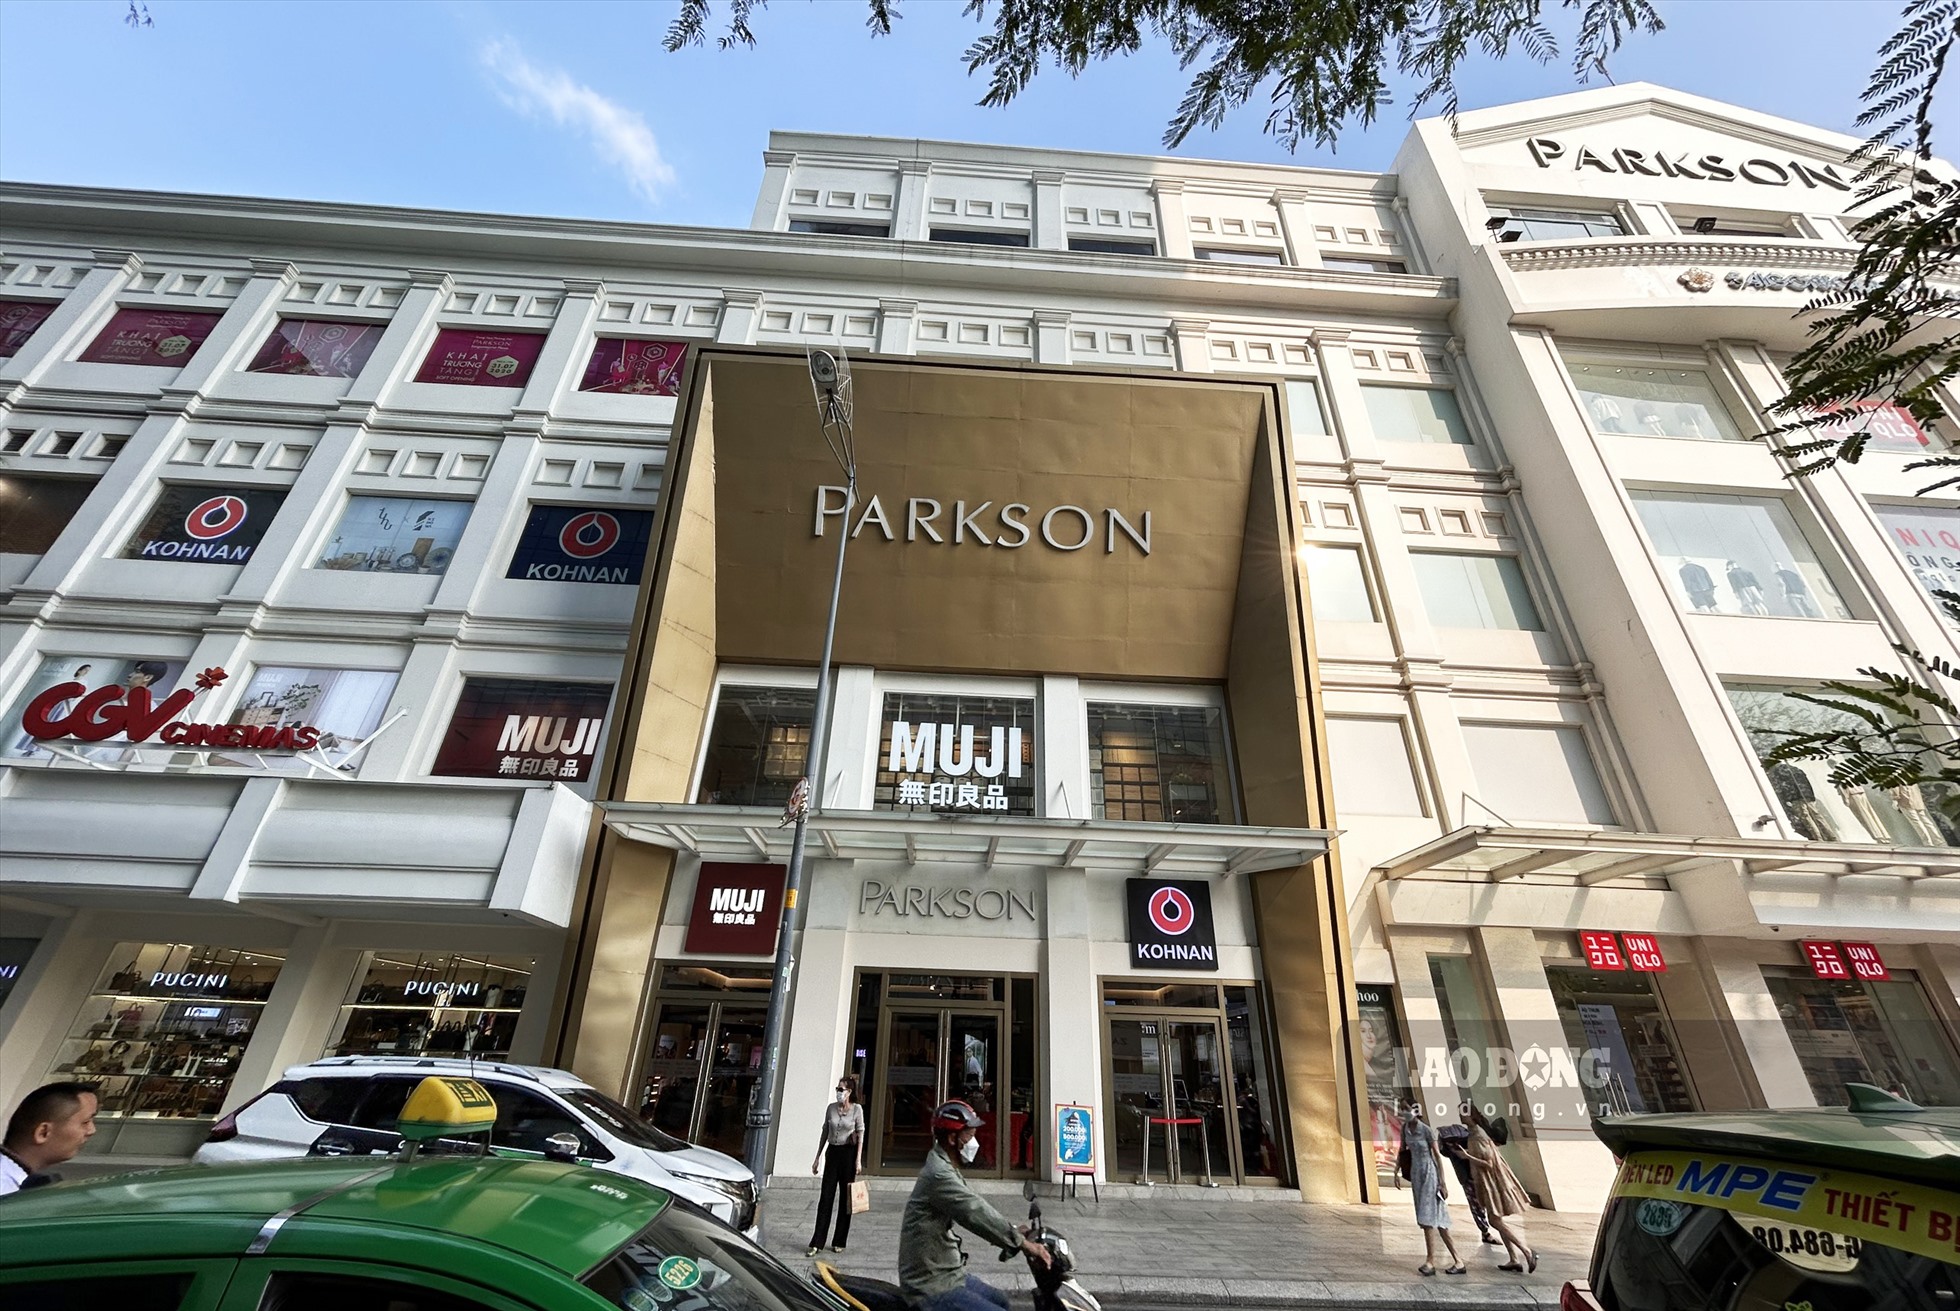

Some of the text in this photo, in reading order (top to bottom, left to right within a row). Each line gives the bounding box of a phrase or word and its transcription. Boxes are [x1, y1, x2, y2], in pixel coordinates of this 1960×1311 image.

[1526, 137, 1851, 191] PARKSON
[117, 331, 160, 339] KHAI
[472, 339, 511, 347] PARKSON
[446, 351, 488, 360] KHAI
[1874, 422, 1917, 438] QLO
[814, 485, 1151, 555] PARKSON
[141, 539, 250, 562] KOHNAN
[526, 562, 629, 584] KOHNAN
[22, 681, 194, 743] CGV
[160, 721, 320, 750] CINEMAS
[496, 714, 602, 755] MUJI
[888, 721, 1022, 778] MUJI
[498, 755, 579, 778] 無印良品
[898, 778, 1009, 810] 無印良品
[709, 887, 765, 913] MUJI
[860, 880, 1037, 922] PARKSON
[712, 912, 756, 926] 無印良品
[1137, 943, 1214, 962] KOHNAN
[1626, 938, 1654, 952] UNI
[1847, 947, 1875, 960] UNI
[1632, 953, 1661, 968] QLO
[1855, 961, 1884, 977] QLO
[150, 972, 228, 988] PUCINI
[403, 981, 480, 996] PUCINI
[1646, 1164, 1674, 1185] LED
[1675, 1160, 1816, 1212] MPE
[1824, 1188, 1916, 1232] THIẾT
[664, 1260, 694, 1287] 5226
